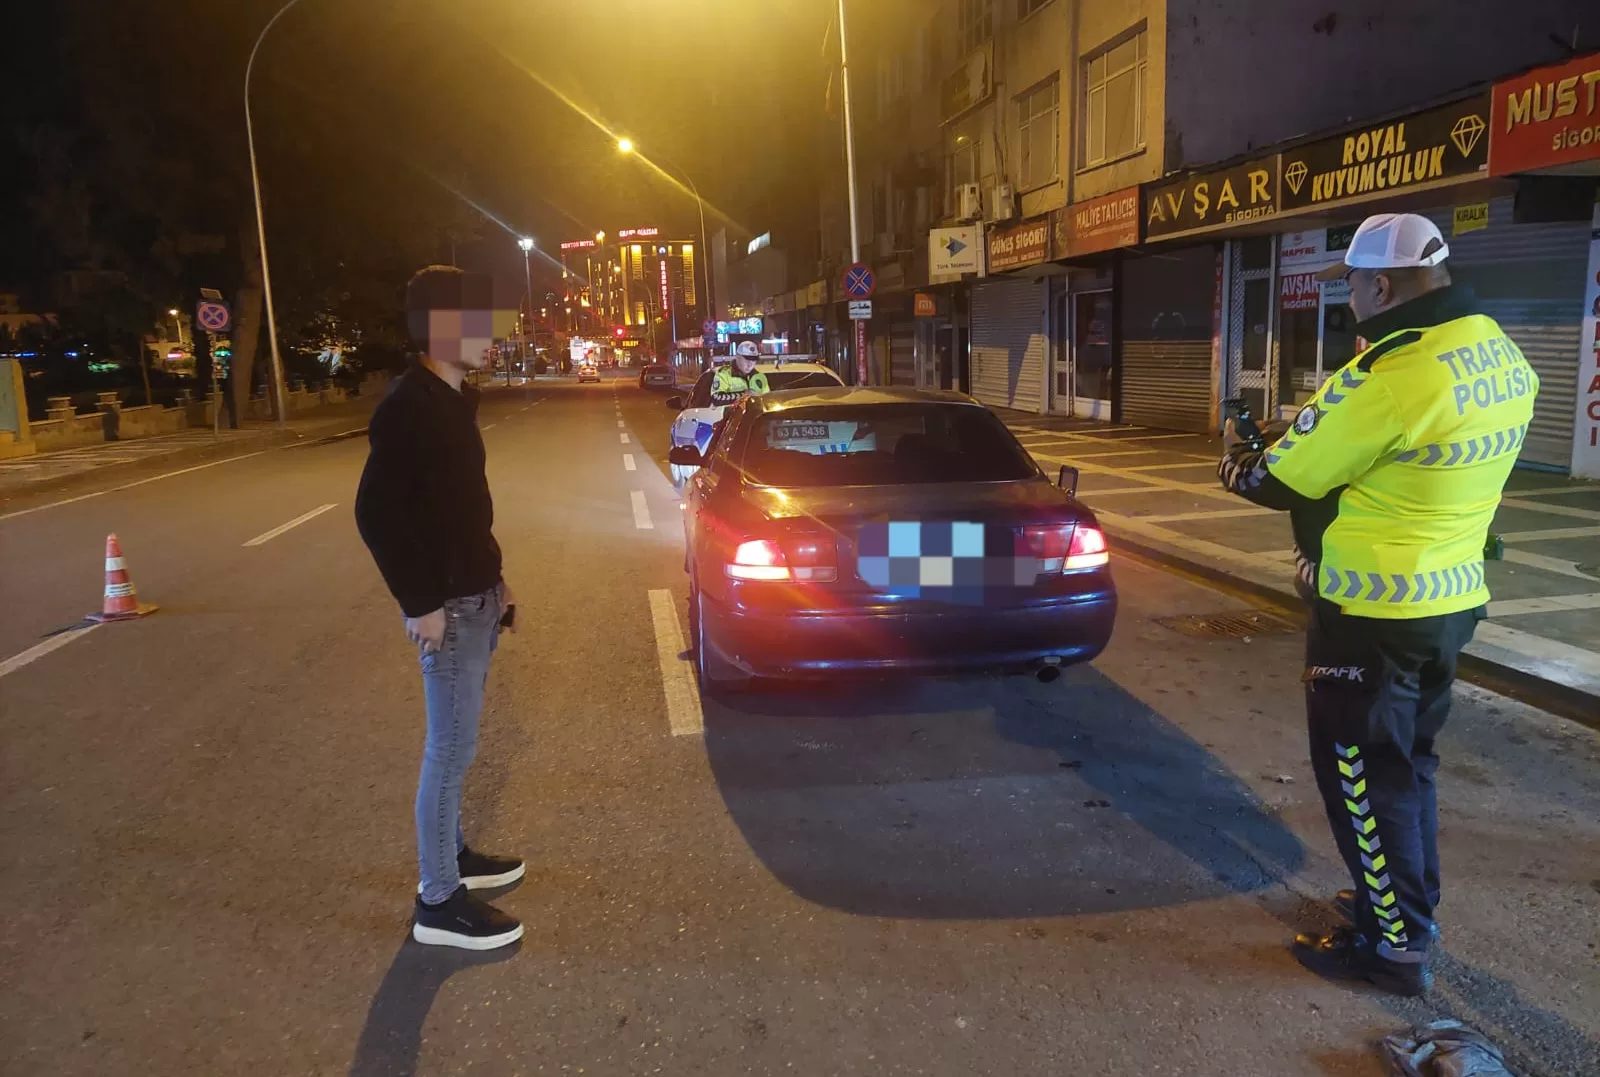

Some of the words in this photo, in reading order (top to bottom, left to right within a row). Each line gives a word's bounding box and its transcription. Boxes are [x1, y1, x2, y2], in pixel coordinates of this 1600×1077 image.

[1342, 123, 1406, 166] ROYAL
[1148, 169, 1271, 221] AVŞAR
[1311, 145, 1446, 202] KUYUMCULUK
[1225, 205, 1275, 223] SİGORTA
[1455, 205, 1488, 223] KIRALIK
[1281, 247, 1317, 258] MAPFRE
[1437, 336, 1522, 380] TRAFİK
[1453, 365, 1531, 416] POLİSİ
